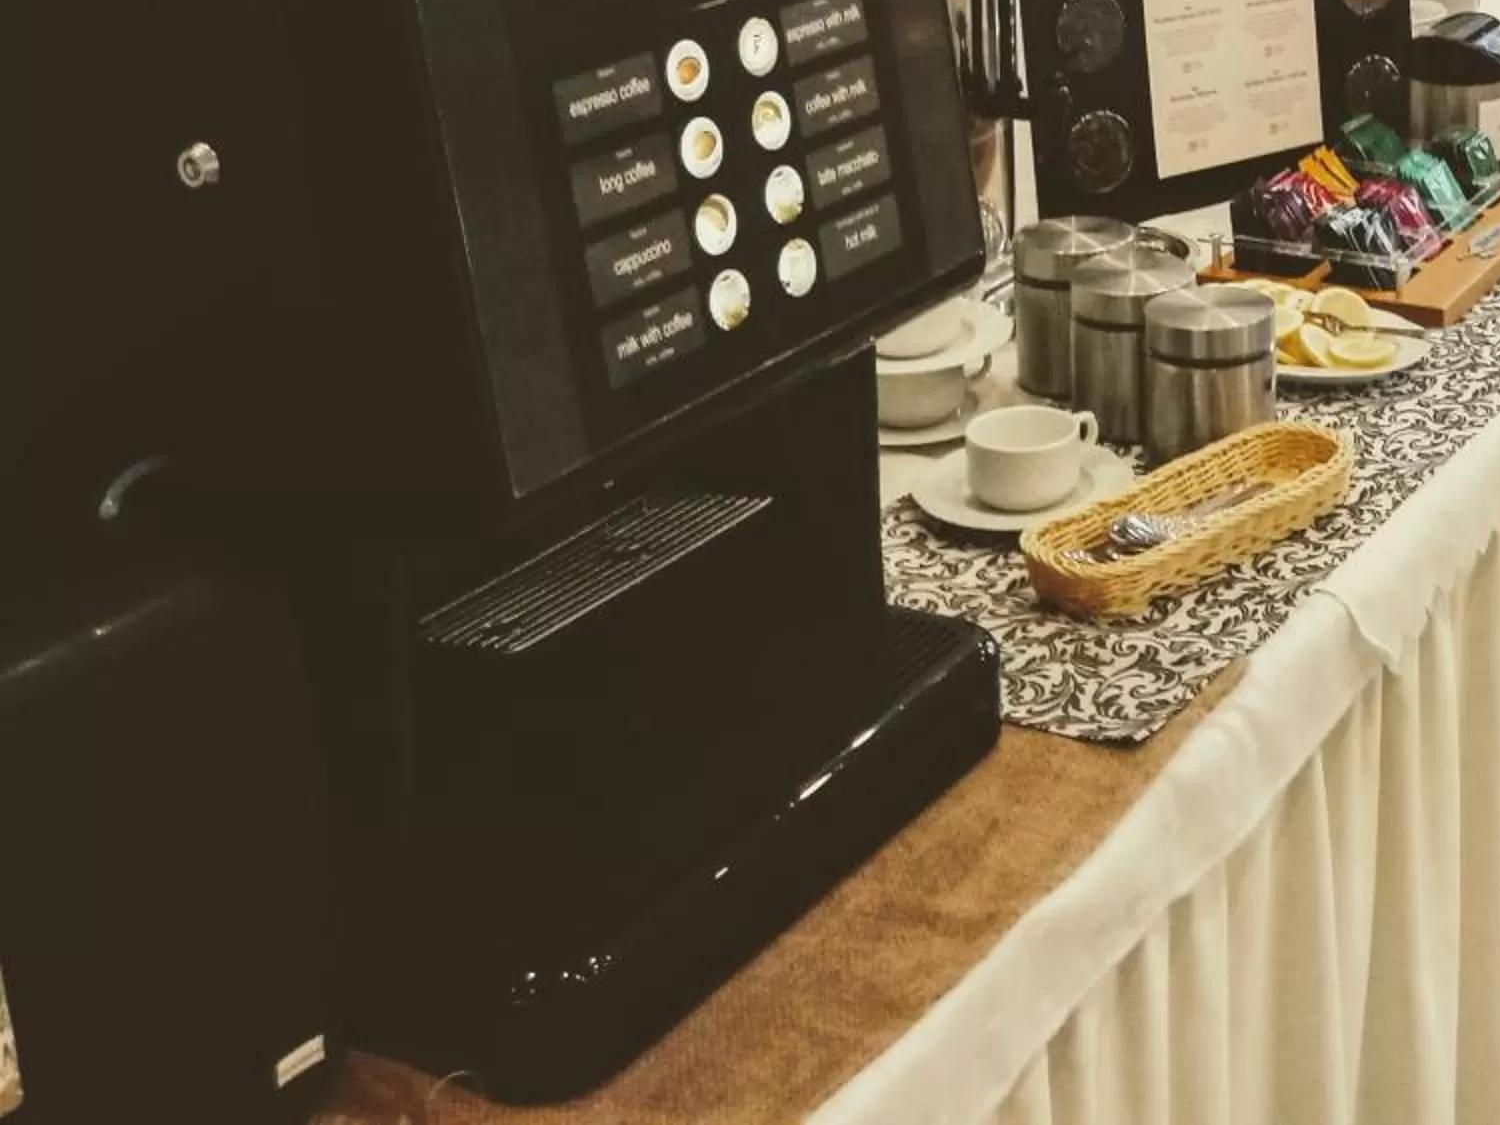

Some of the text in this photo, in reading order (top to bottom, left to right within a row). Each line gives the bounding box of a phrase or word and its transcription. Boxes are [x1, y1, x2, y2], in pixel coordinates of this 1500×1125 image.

[825, 10, 843, 29] with
[843, 3, 861, 24] milk
[569, 77, 650, 118] espresso coffee
[805, 93, 831, 116] coffee
[831, 85, 849, 105] with
[849, 78, 868, 98] milk
[599, 159, 656, 196] long coffee
[844, 224, 878, 251] hot milk
[613, 238, 672, 276] cappuccino
[616, 334, 640, 360] milk
[640, 326, 663, 348] with
[663, 311, 694, 338] coffee
